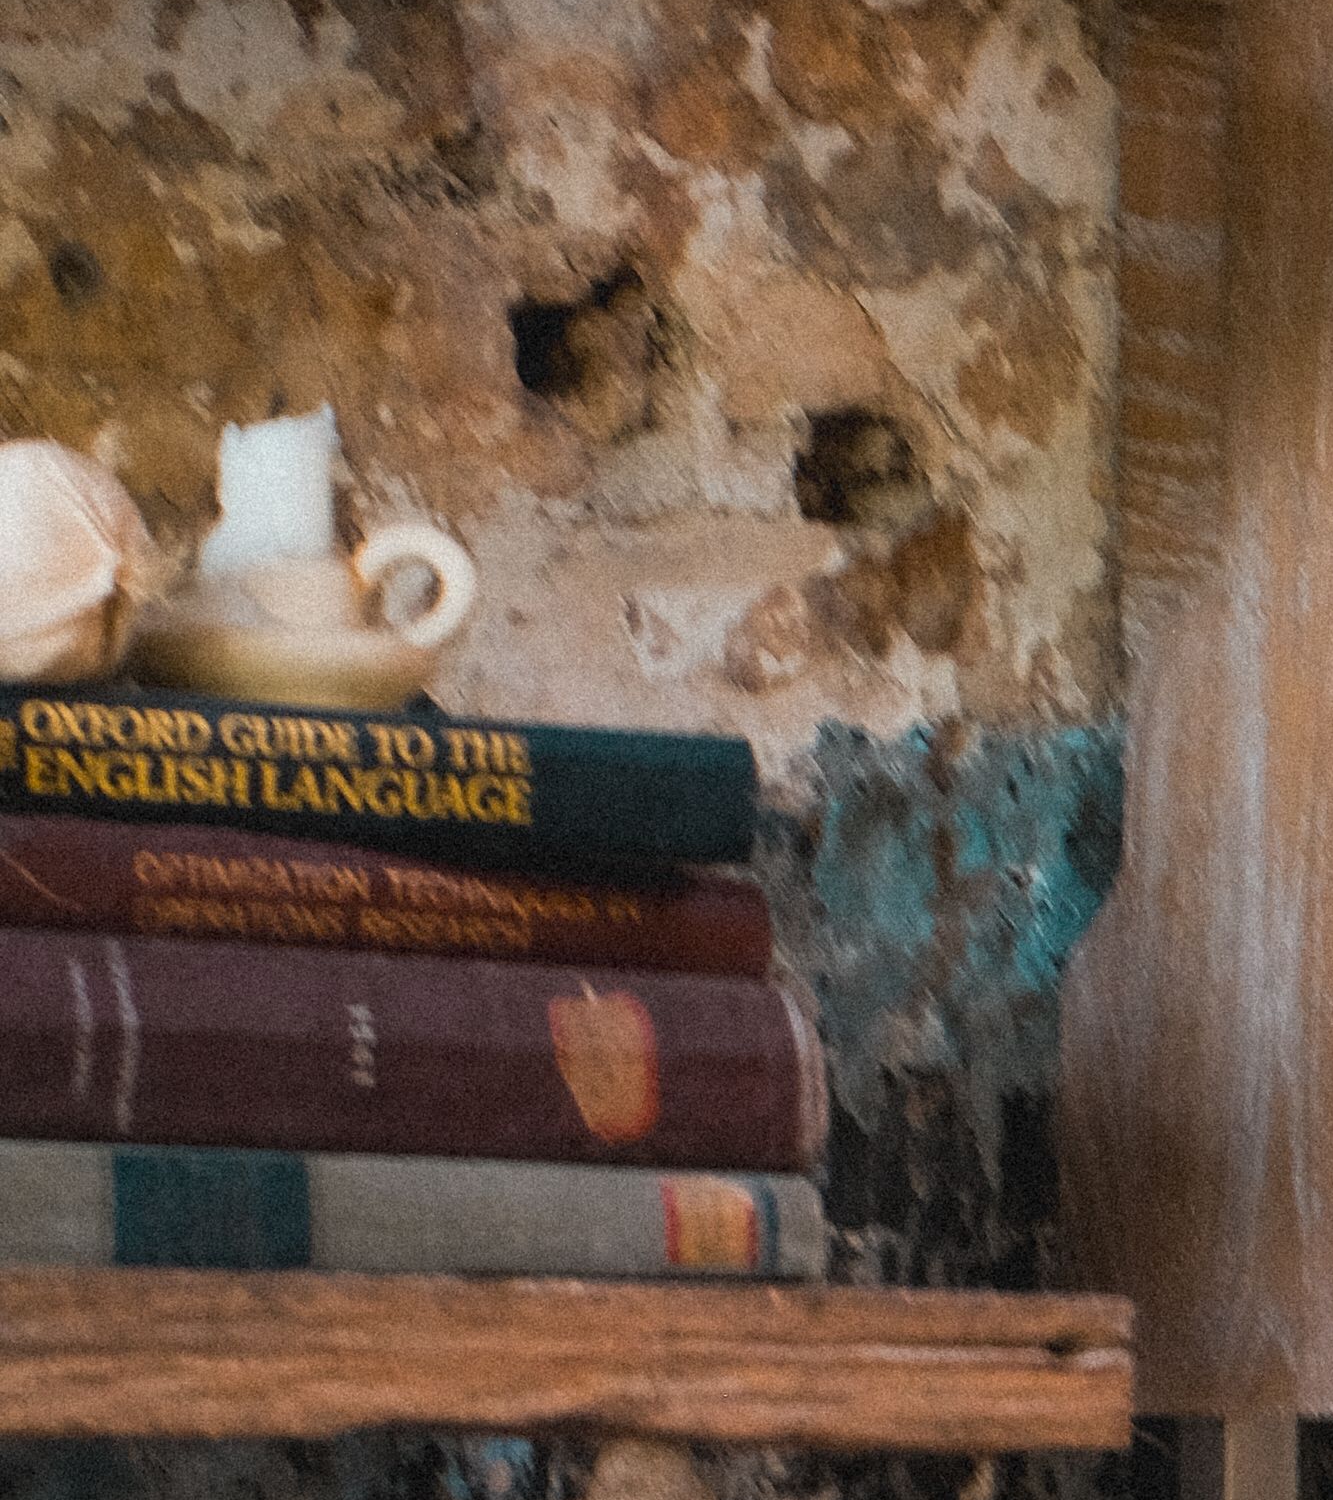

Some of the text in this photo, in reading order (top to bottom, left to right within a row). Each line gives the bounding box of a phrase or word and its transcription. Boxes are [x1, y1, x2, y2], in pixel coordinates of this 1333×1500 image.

[20, 698, 213, 755] OXFORD
[219, 713, 361, 763] GUIDE
[366, 721, 437, 768] TO
[442, 727, 534, 775] THE
[24, 746, 534, 825] ENGLISH LANGUAGE
